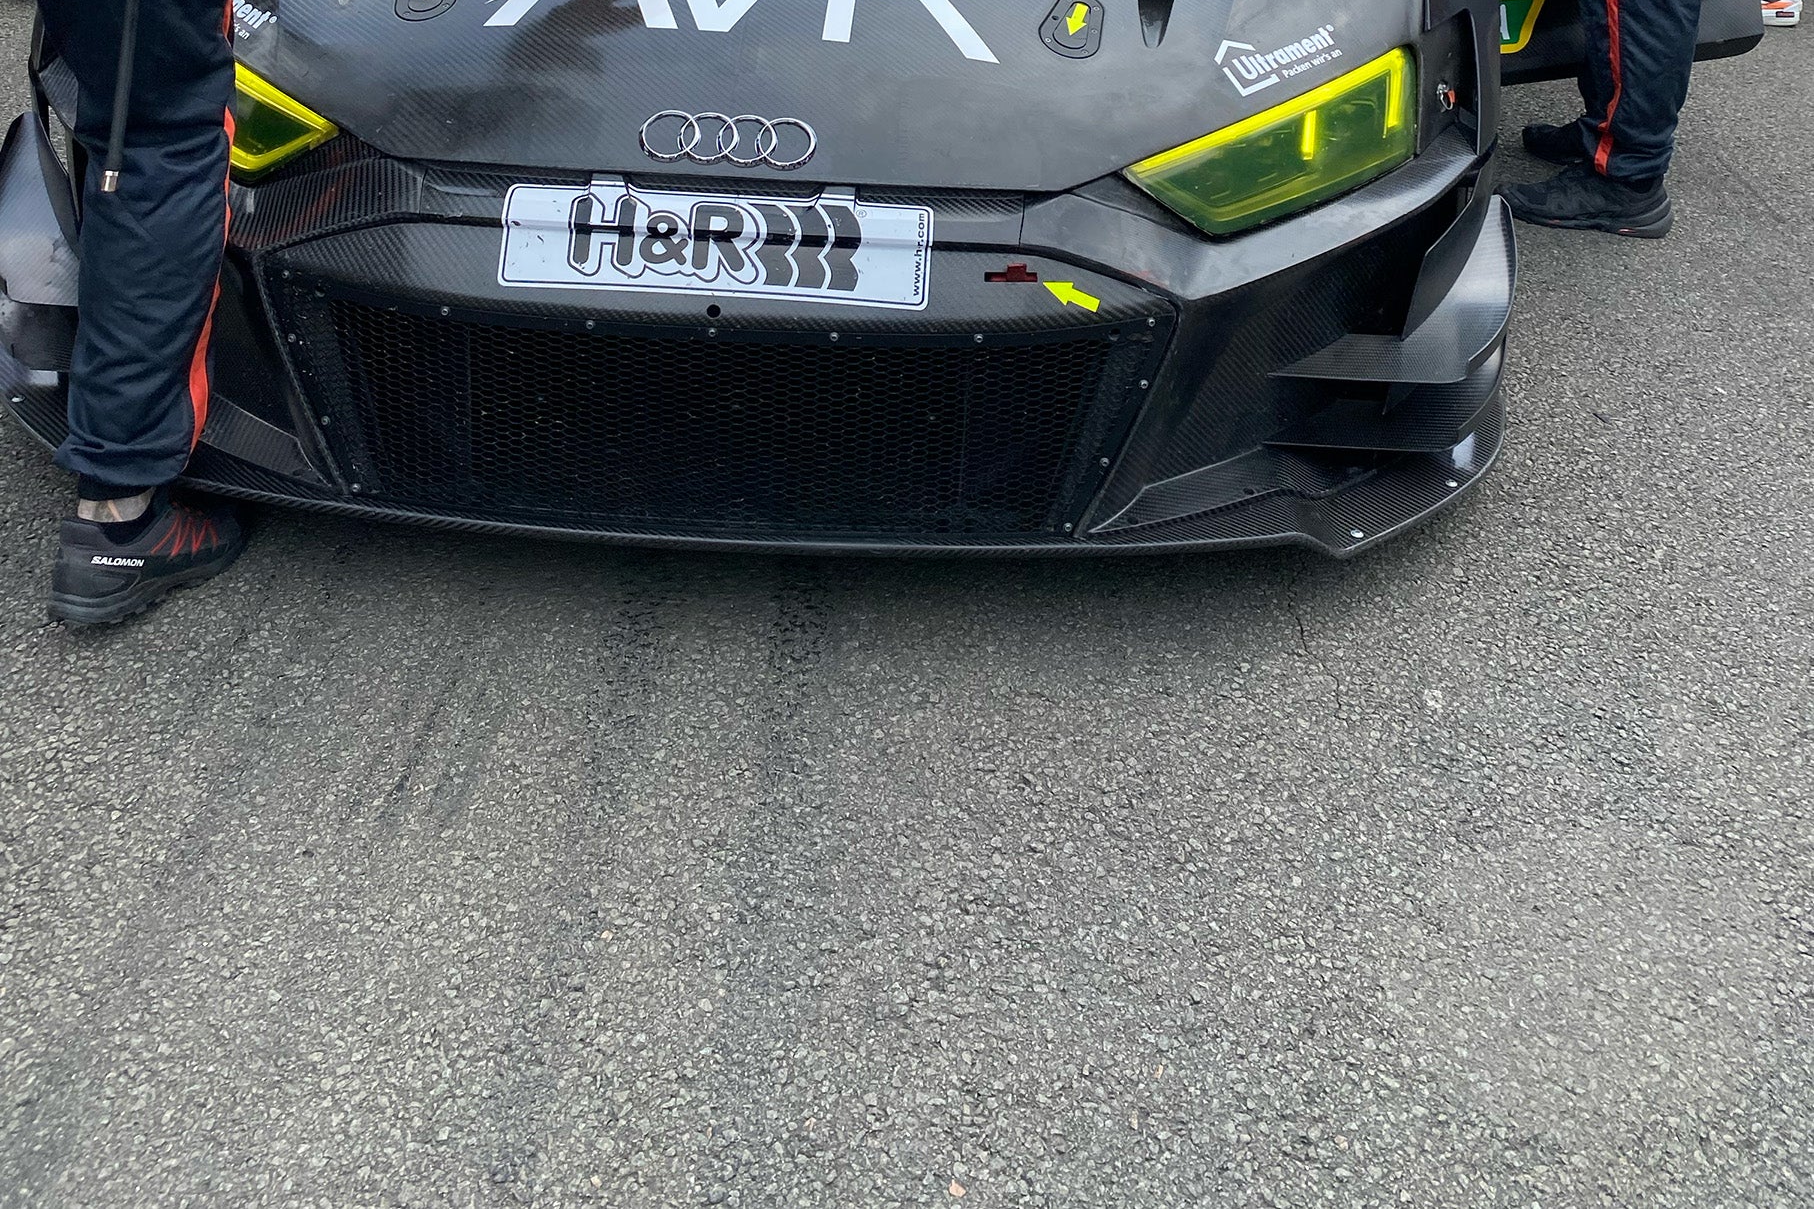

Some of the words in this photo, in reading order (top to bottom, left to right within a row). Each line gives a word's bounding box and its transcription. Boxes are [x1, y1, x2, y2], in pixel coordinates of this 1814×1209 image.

[1281, 59, 1313, 79] Packen
[1330, 48, 1343, 59] an
[566, 192, 761, 284] H&R
[90, 555, 145, 567] SALOMON
